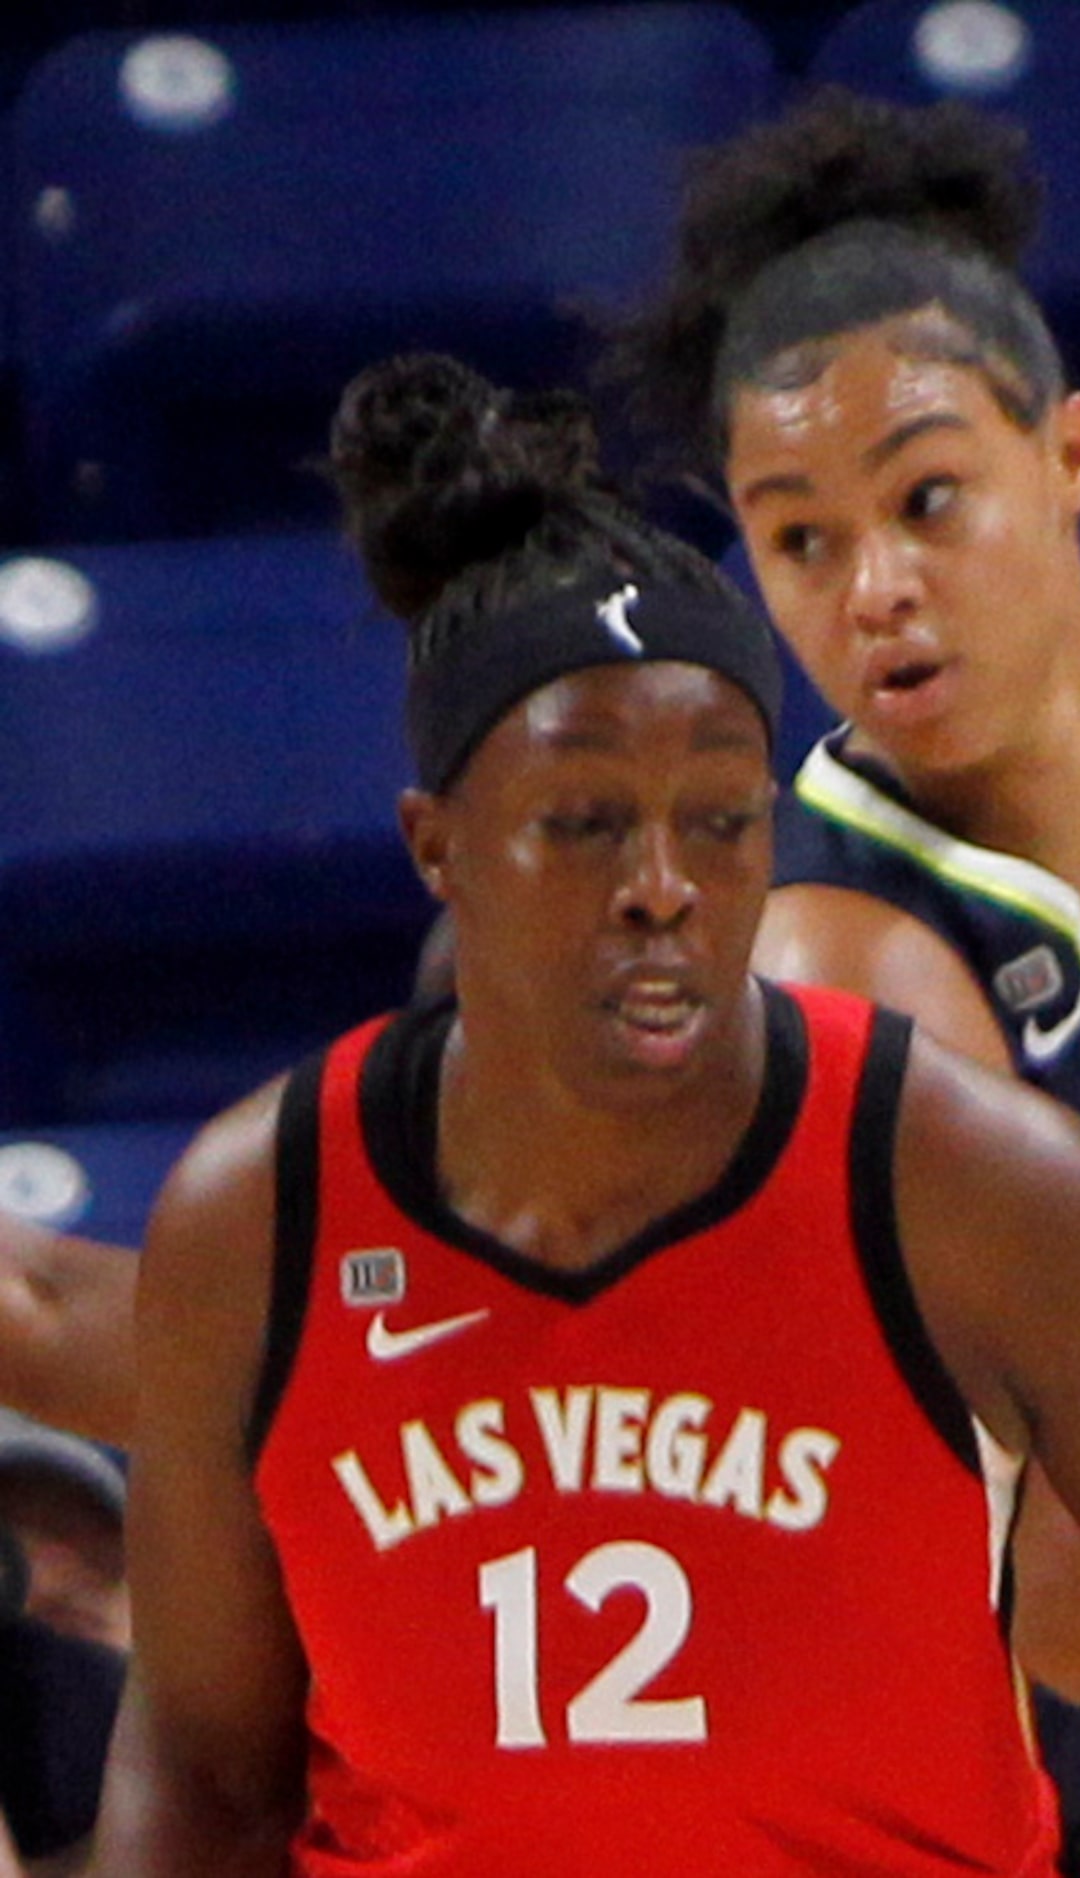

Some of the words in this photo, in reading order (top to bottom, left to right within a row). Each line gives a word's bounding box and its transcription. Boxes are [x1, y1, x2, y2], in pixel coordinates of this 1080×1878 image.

[331, 1397, 525, 1553] LAS
[529, 1384, 842, 1532] VEGAS
[478, 1539, 708, 1749] 12
